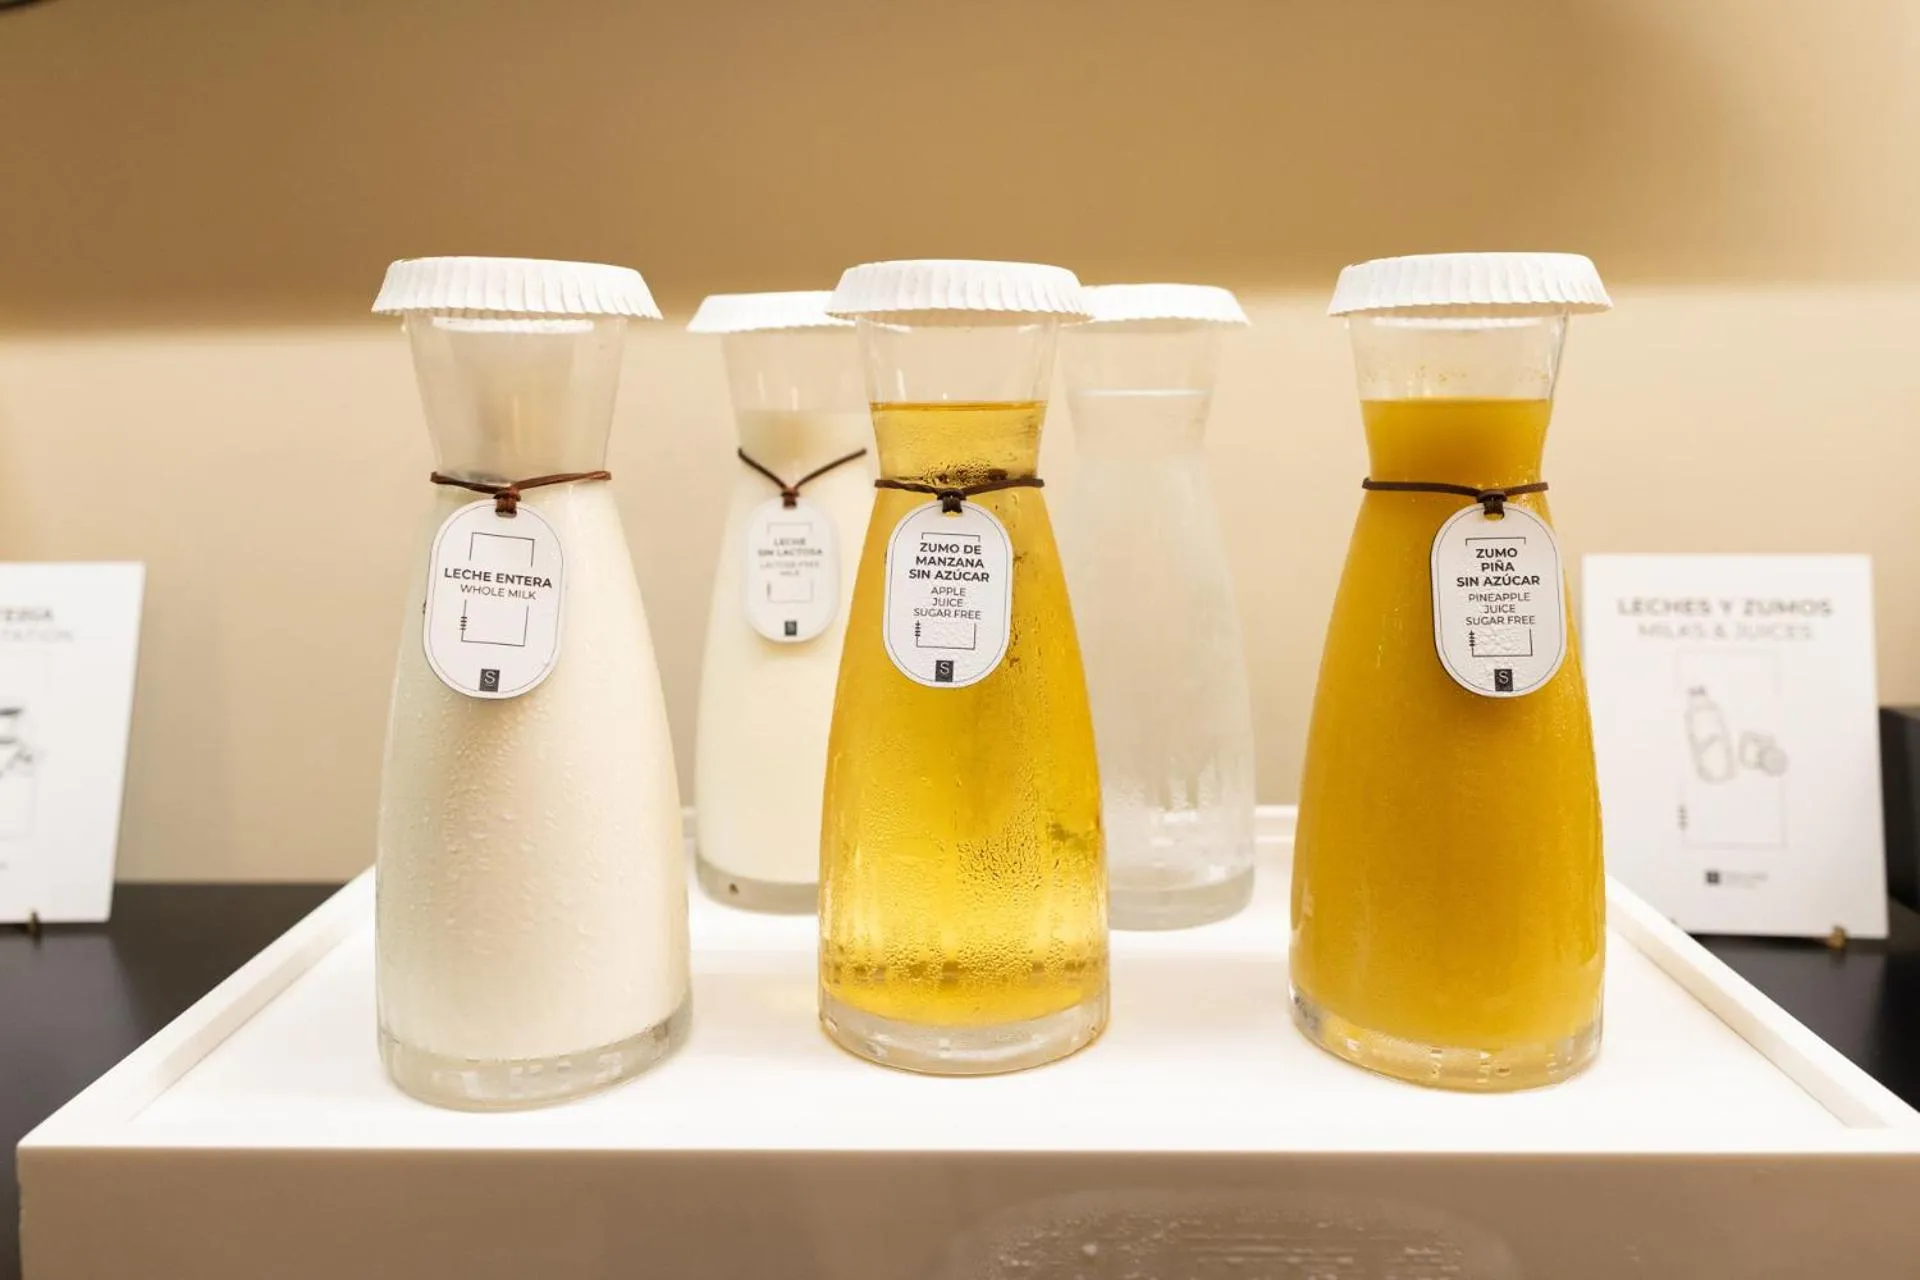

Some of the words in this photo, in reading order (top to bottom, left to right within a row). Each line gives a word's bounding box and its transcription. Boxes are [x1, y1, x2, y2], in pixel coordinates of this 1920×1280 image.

[774, 537, 807, 547] LECHE
[919, 542, 960, 554] ZUMO
[963, 543, 982, 555] DE
[1475, 547, 1518, 559] ZUMO
[915, 556, 984, 569] MANZANA
[1480, 559, 1516, 572] PIÑA
[444, 567, 492, 582] LECHE
[495, 574, 553, 588] ENTERA
[908, 568, 931, 580] SIN
[933, 568, 990, 583] AZÚCAR
[1456, 576, 1480, 587] SIN
[1483, 573, 1540, 586] AZÚCAR
[460, 583, 505, 597] WHOLE
[507, 588, 537, 600] MILK
[931, 586, 967, 596] APPLE
[1468, 592, 1531, 602] PINEAPPLE
[932, 597, 964, 607] JUICE
[1617, 597, 1711, 617] LECHES
[1719, 598, 1733, 615] Y
[1743, 597, 1835, 618] ZUMOS
[913, 608, 952, 618] SUGAR
[953, 609, 982, 620] FREE
[1484, 604, 1516, 614] JUICE
[1465, 616, 1505, 626] SUGAR
[1507, 615, 1536, 625] FREE
